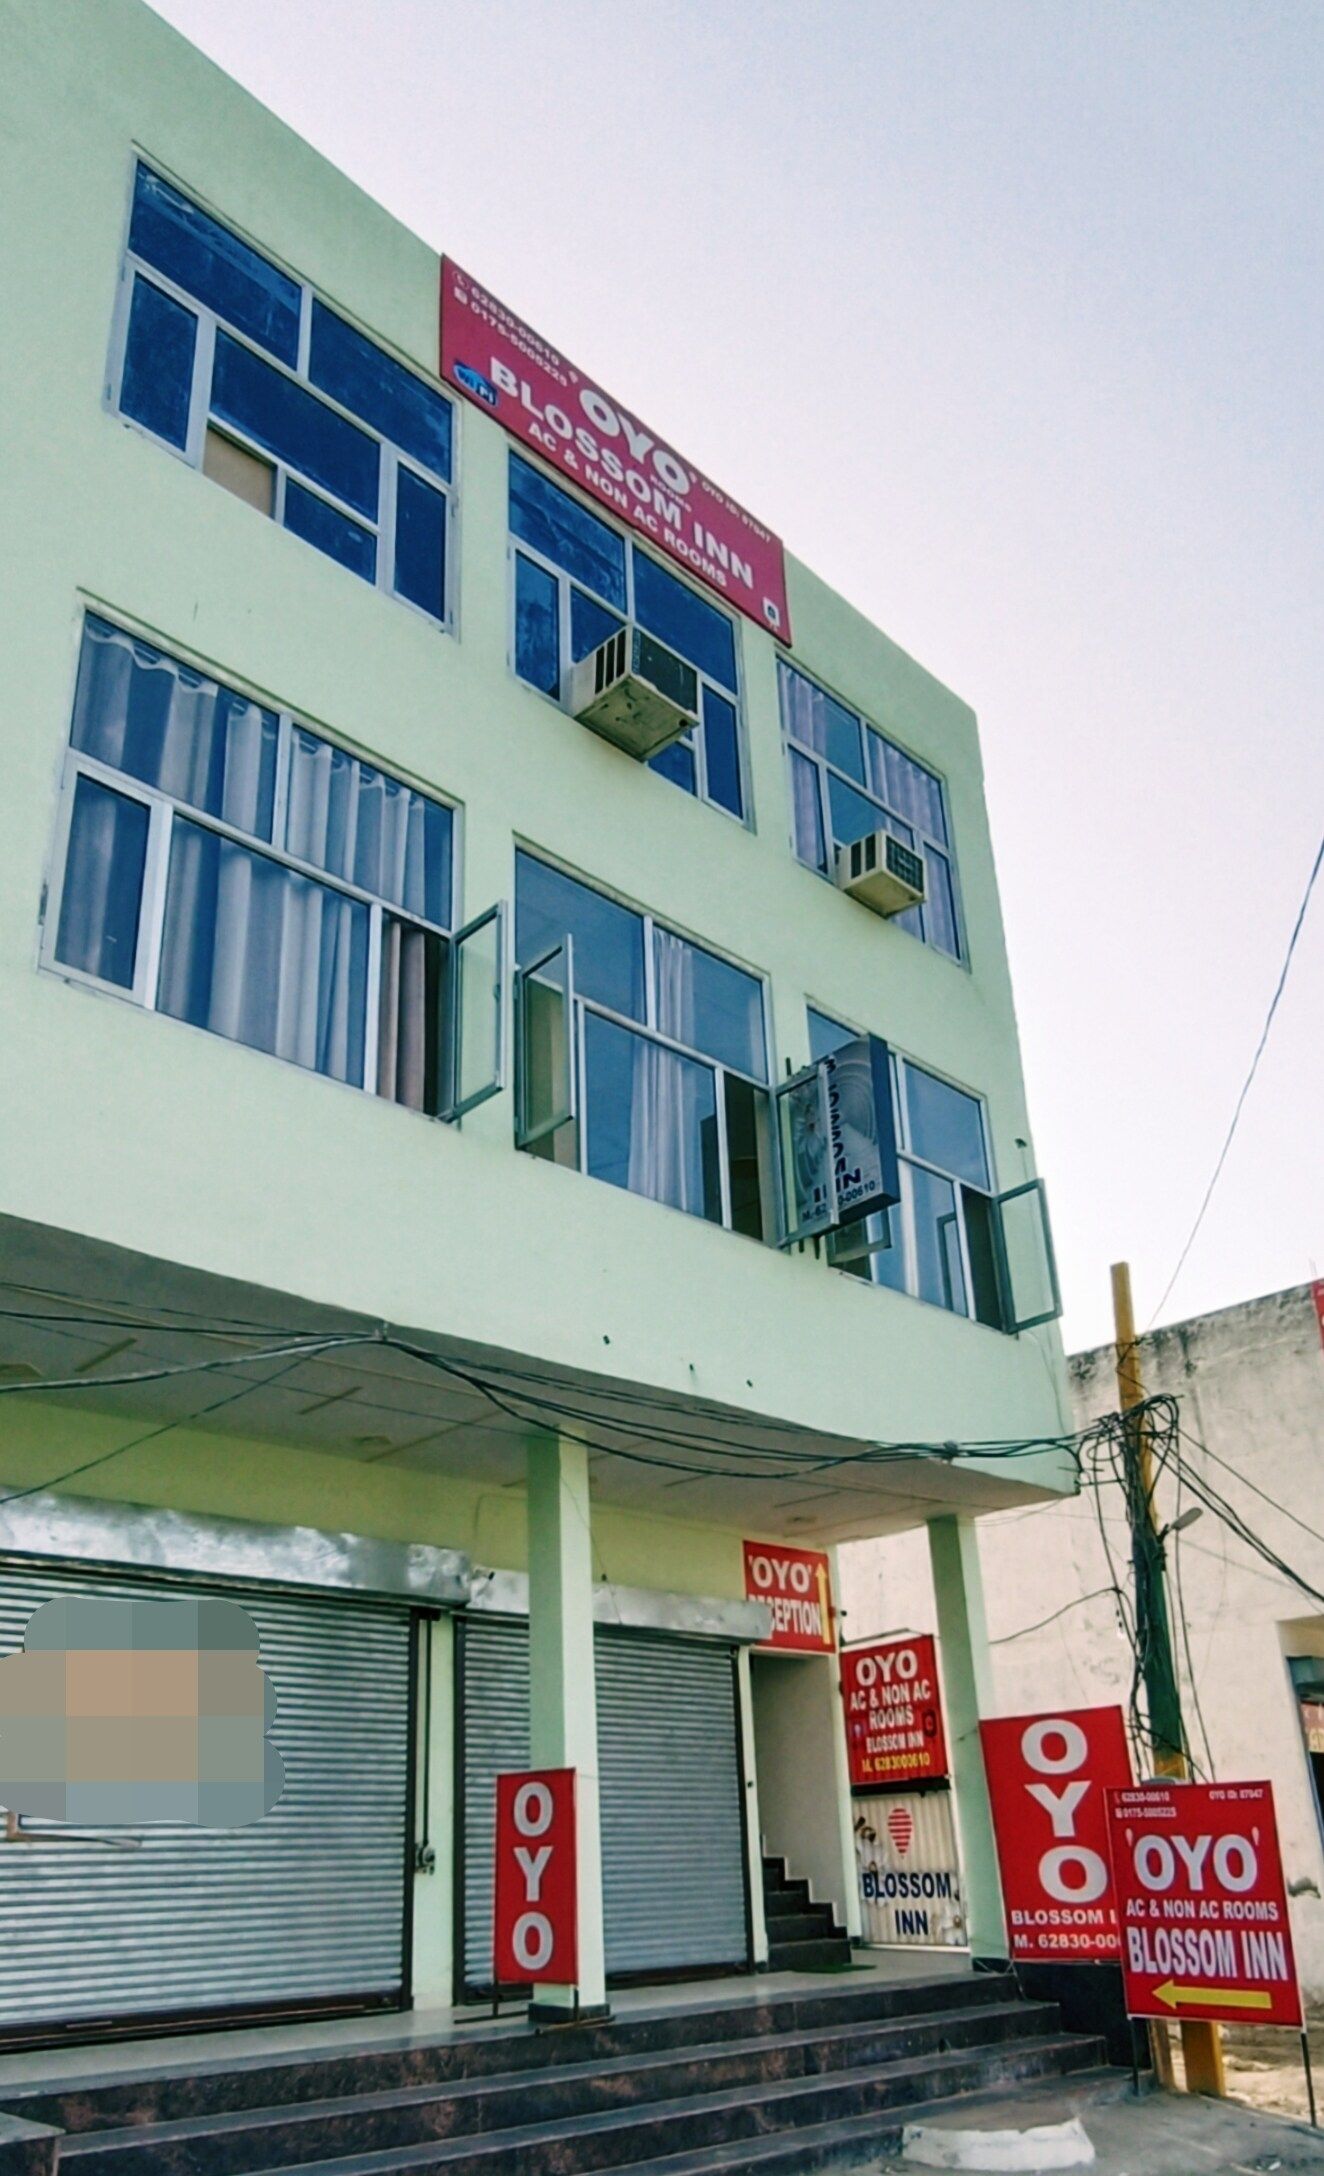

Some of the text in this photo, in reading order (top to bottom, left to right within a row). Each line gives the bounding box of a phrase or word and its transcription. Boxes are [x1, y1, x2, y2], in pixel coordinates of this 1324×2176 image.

[490, 356, 754, 589] BLOSSOM INN
[528, 422, 728, 588] AC & NON AC ROOMS
[748, 1594, 822, 1636] EPTION
[856, 1649, 919, 1687] OYO
[850, 1679, 931, 1711] AC & NON AC
[869, 1705, 914, 1731] ROOMS
[866, 1733, 906, 1754] BLOSSOM
[1021, 1718, 1109, 1904] OYO
[512, 1780, 555, 1971] OYO
[862, 1871, 952, 1899] BLOSSOM
[894, 1908, 929, 1936] INN
[1011, 1909, 1104, 1925] BLOSSOM
[1126, 1898, 1279, 1921] AC & NON AC ROOMS
[1037, 1932, 1121, 1949] 62830-00
[1126, 1926, 1289, 1981] BLOSSOM INN
